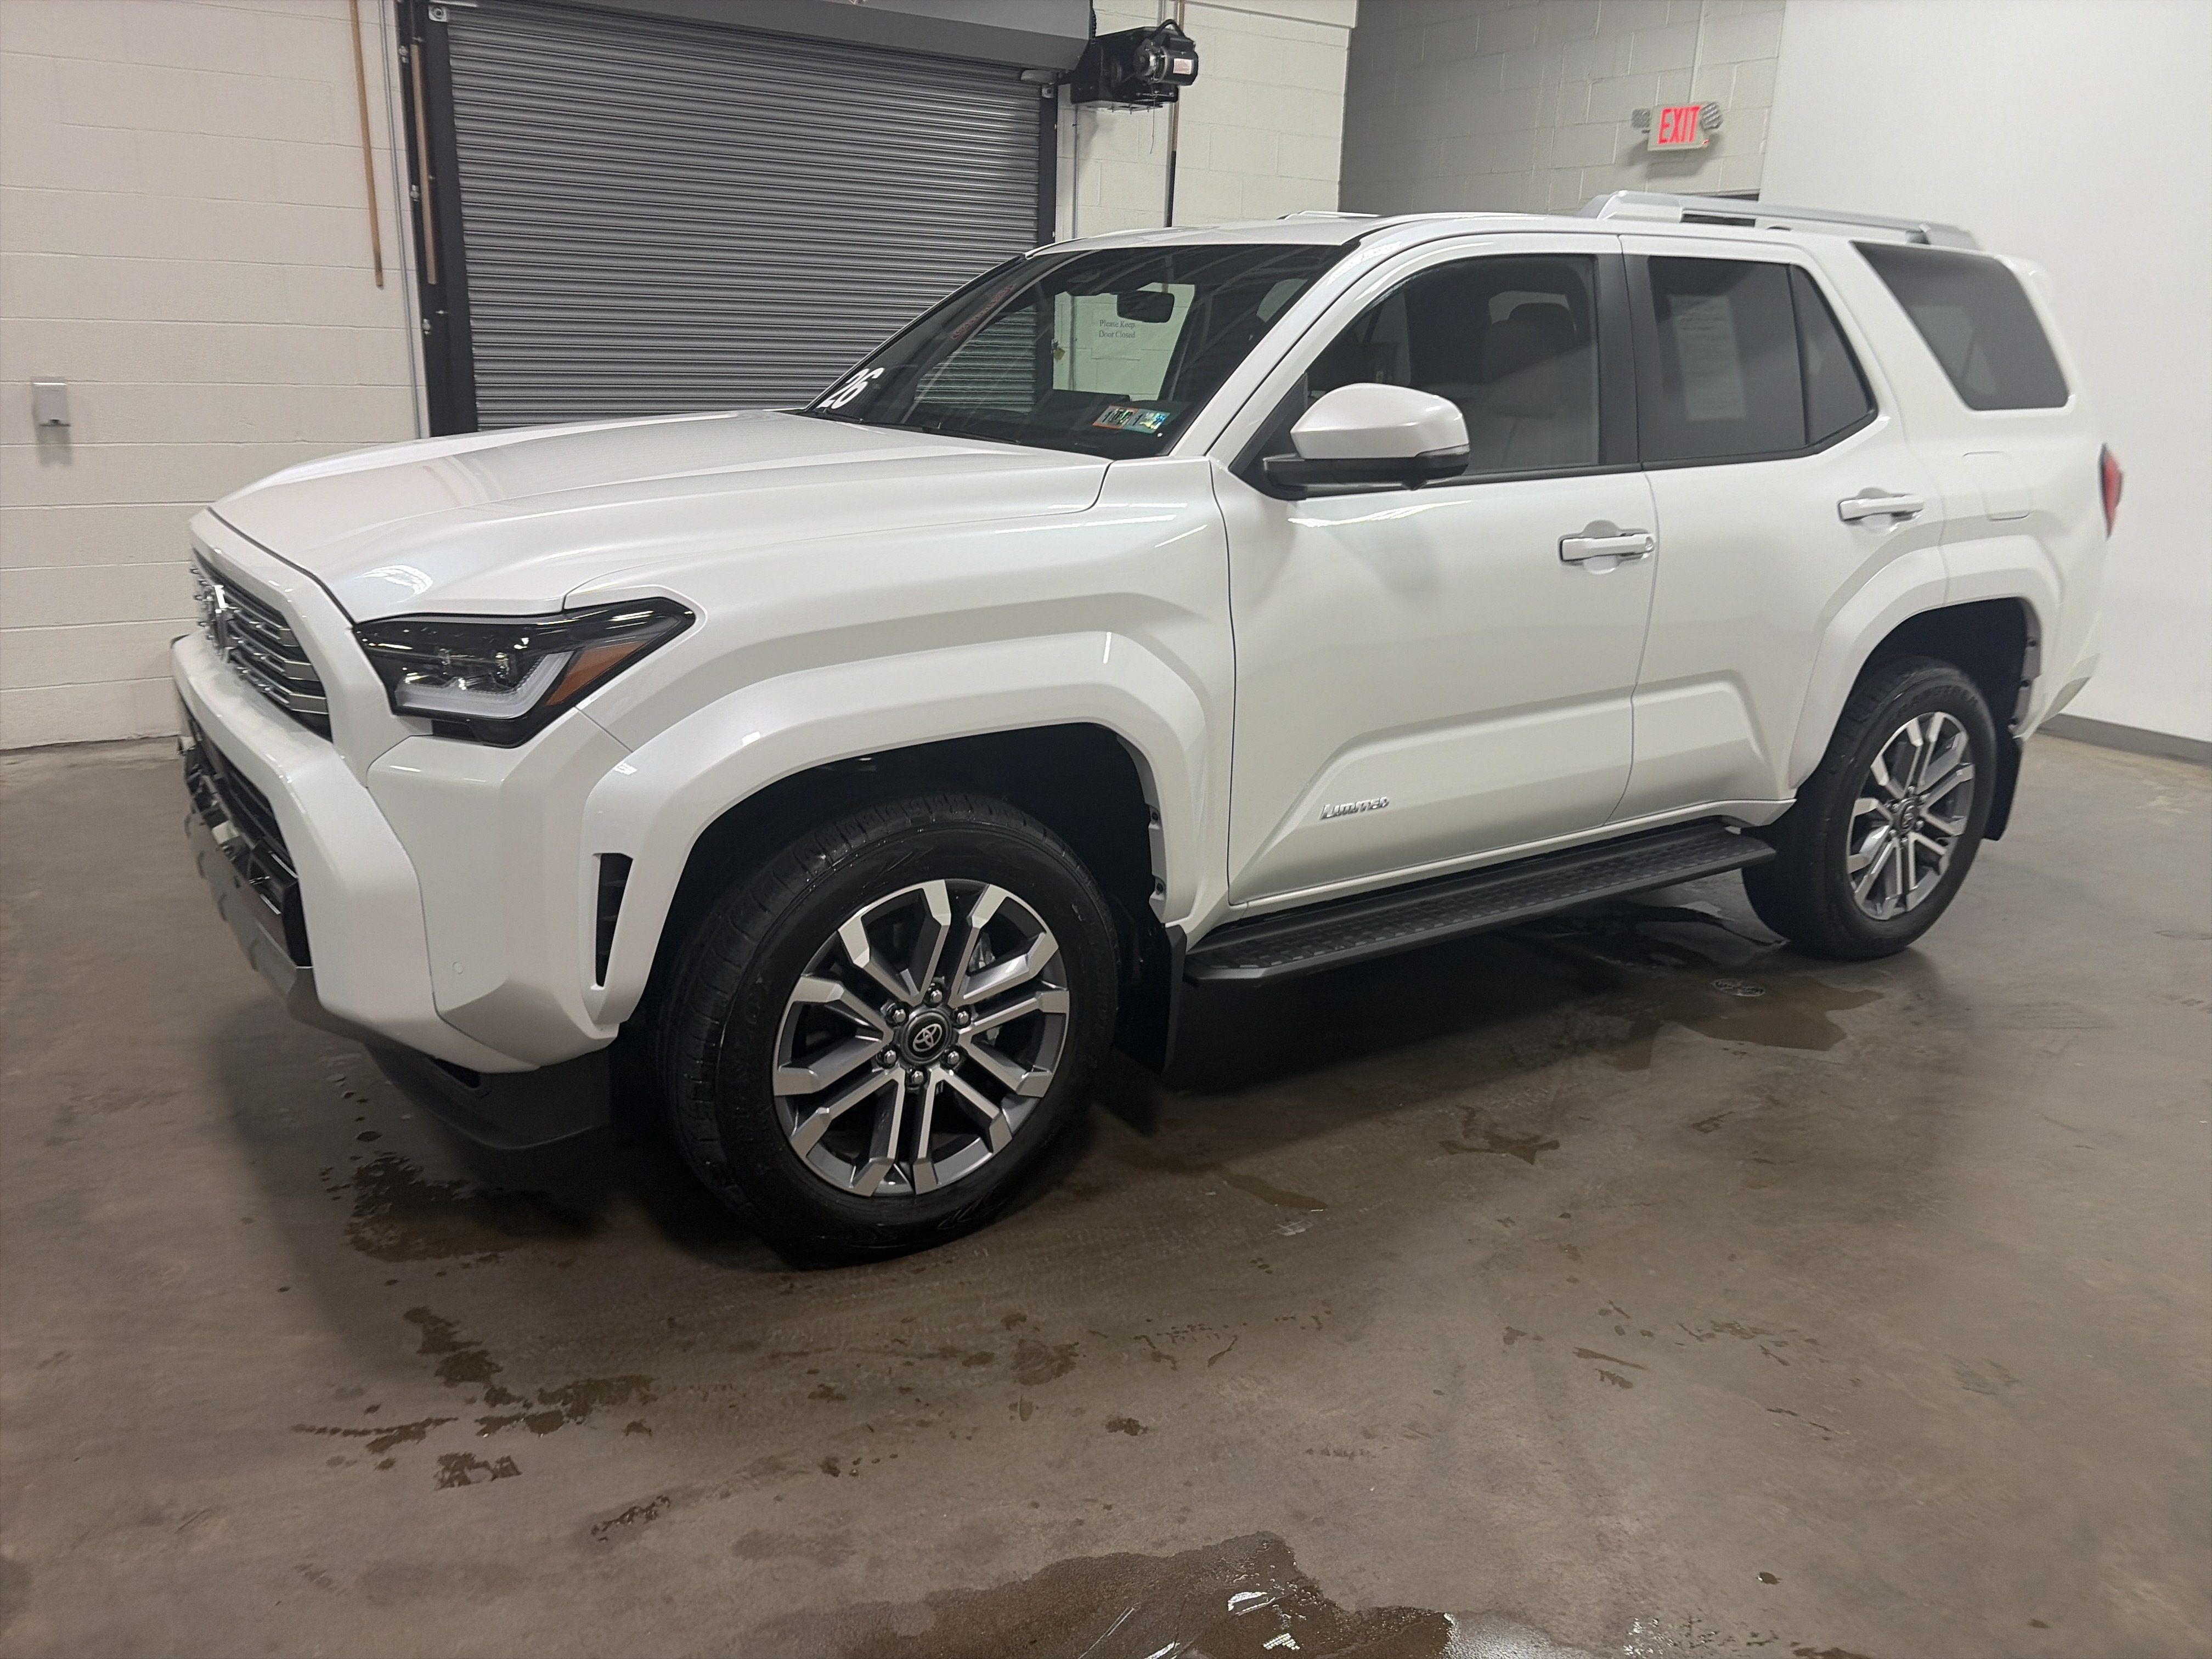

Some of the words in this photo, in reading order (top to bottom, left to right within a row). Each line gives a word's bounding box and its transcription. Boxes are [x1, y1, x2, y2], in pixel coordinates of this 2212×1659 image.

[1658, 106, 1701, 144] EXIT
[1099, 319, 1119, 328] Please
[1120, 320, 1135, 329] Keep
[816, 367, 885, 409] 26
